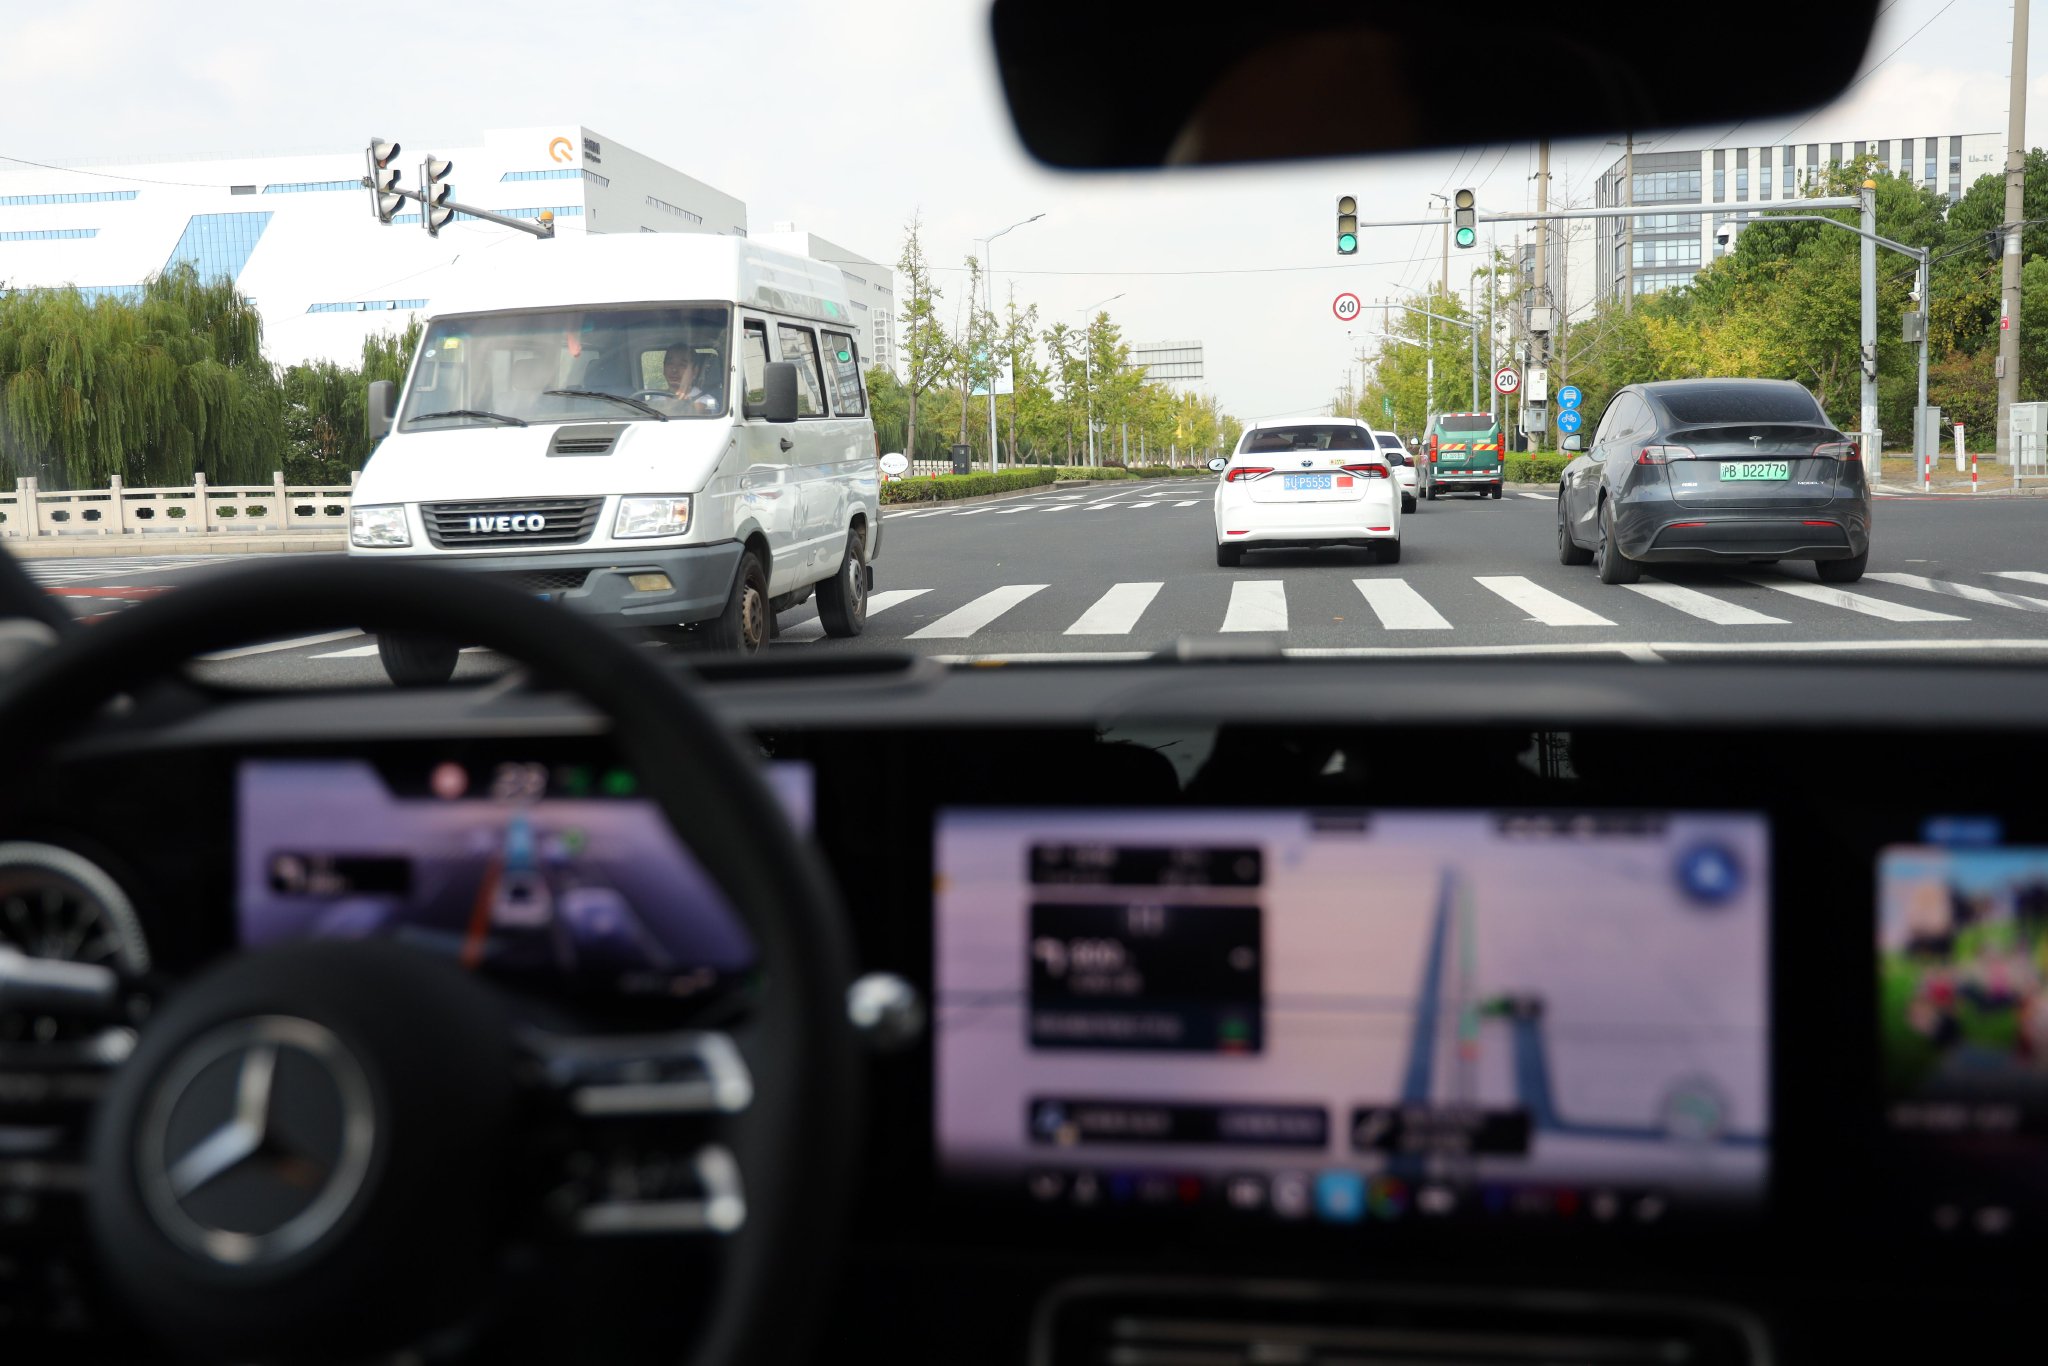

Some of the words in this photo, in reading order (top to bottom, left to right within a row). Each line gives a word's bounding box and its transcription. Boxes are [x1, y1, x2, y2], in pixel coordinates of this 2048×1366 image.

[1339, 301, 1355, 313] 60
[1499, 375, 1517, 386] 20t
[469, 514, 545, 534] IVECO
